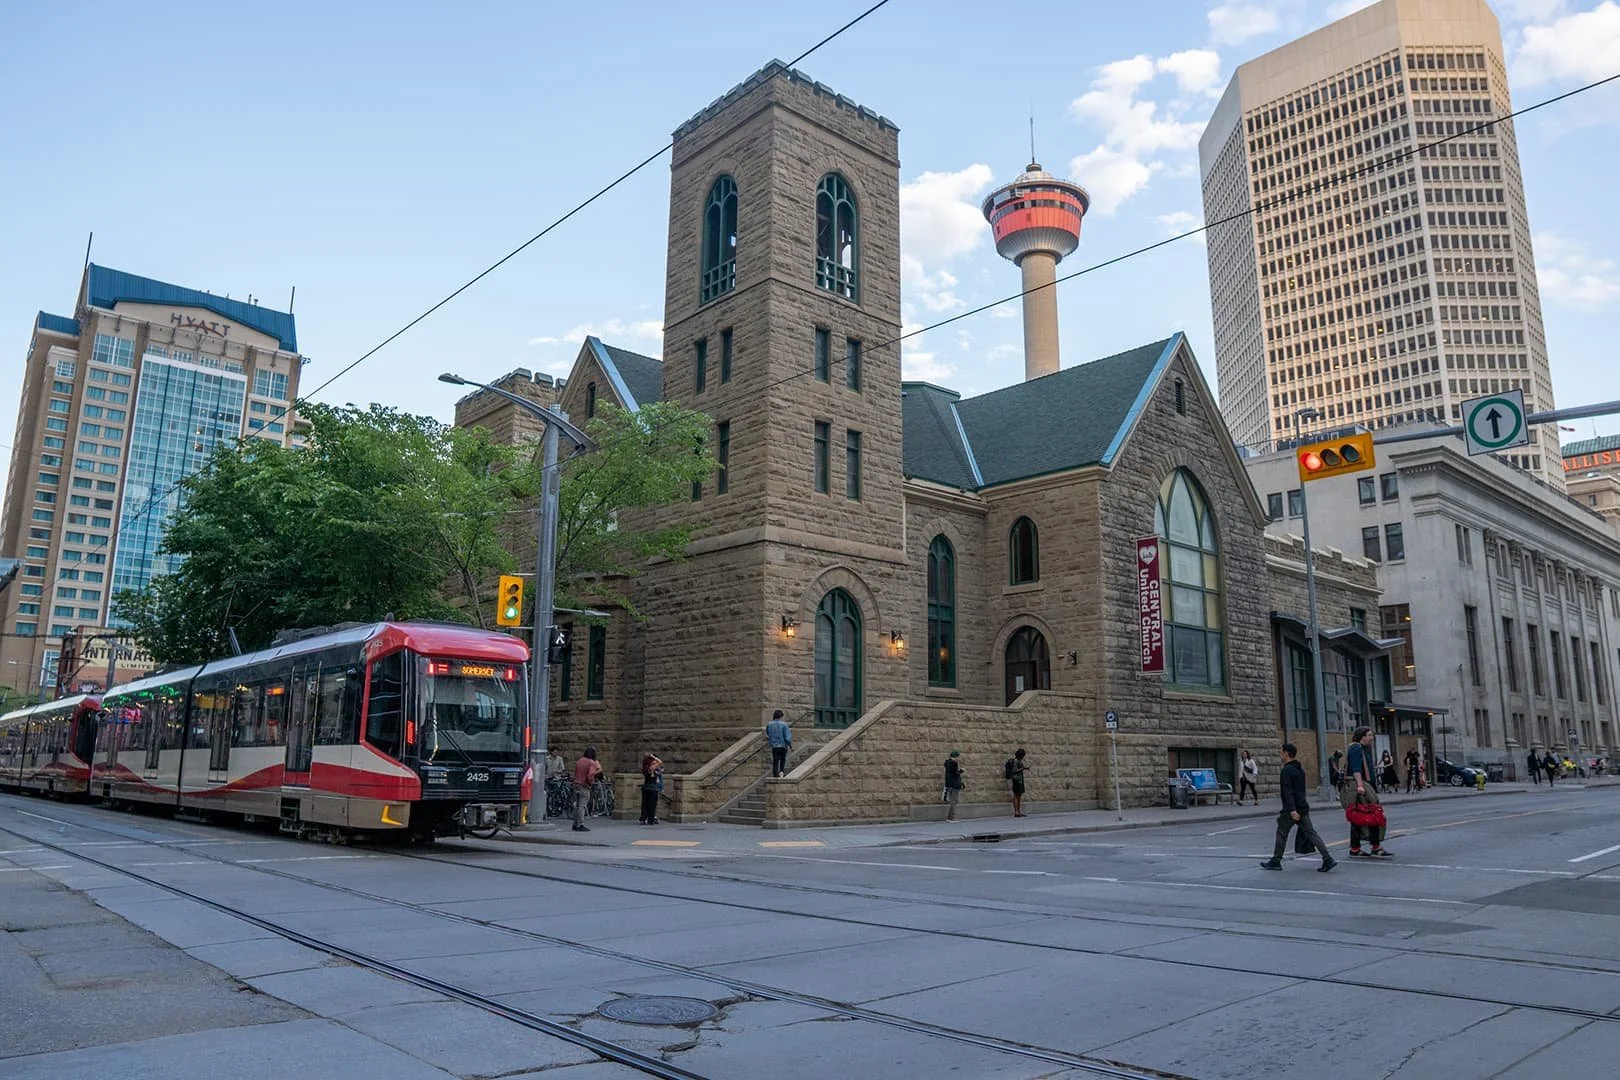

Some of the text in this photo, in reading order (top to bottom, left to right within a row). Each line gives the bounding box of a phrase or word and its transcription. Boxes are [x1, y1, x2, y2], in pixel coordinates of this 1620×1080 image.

[171, 312, 231, 336] HYATT
[1140, 568, 1150, 613] United
[1150, 579, 1161, 651] CENTRAL
[1141, 616, 1152, 665] Church
[462, 665, 494, 677] SOMERSET
[466, 773, 489, 782] 2425
